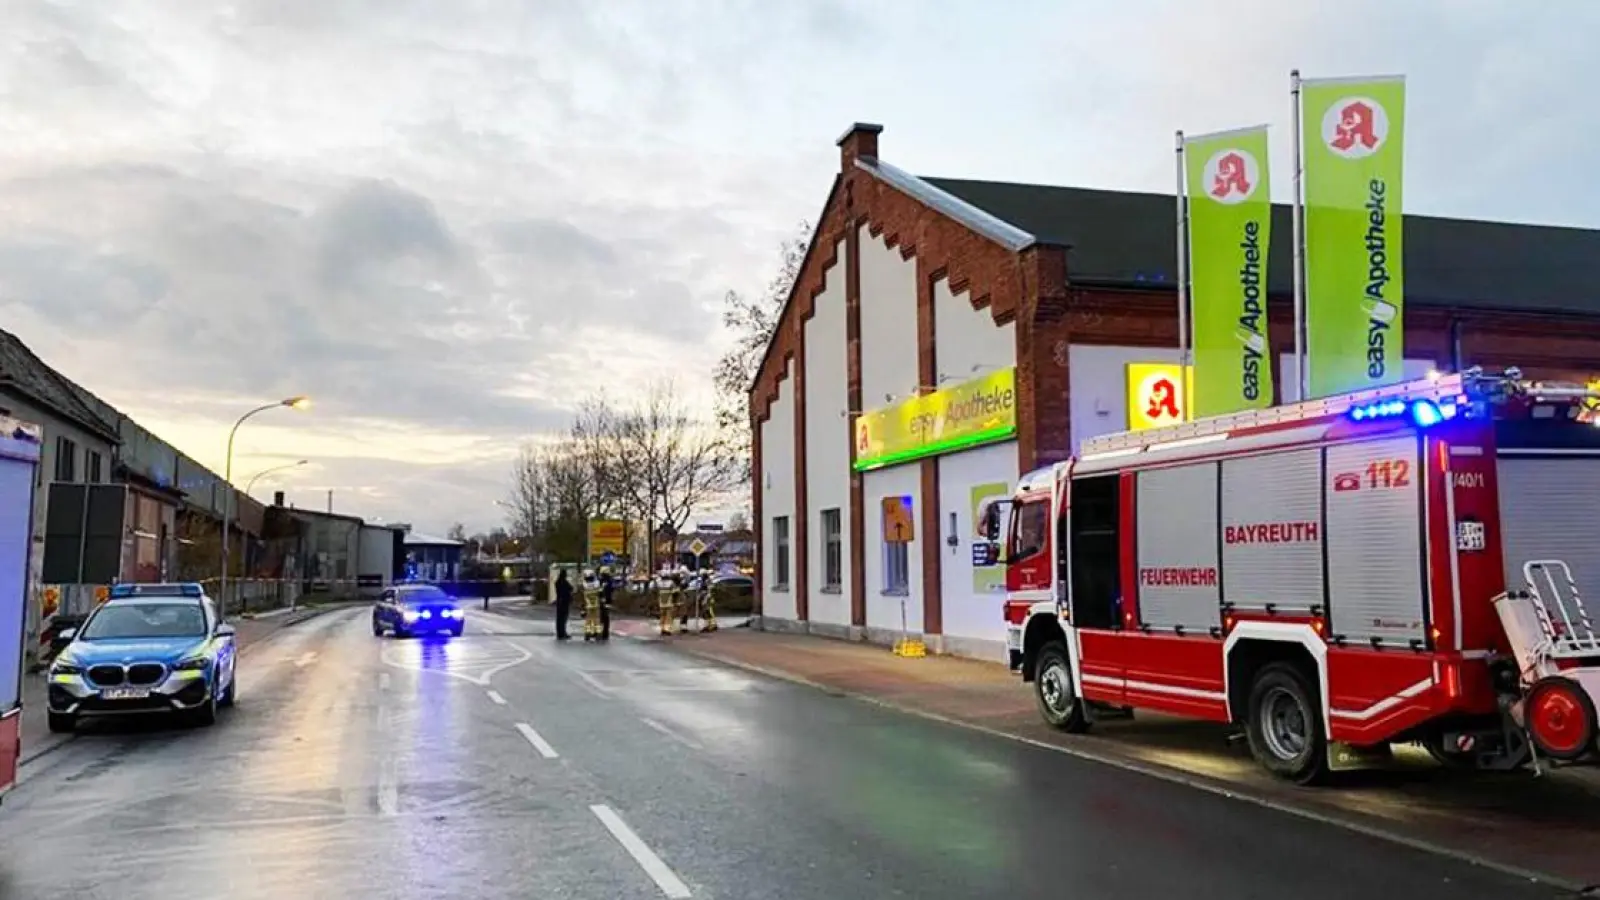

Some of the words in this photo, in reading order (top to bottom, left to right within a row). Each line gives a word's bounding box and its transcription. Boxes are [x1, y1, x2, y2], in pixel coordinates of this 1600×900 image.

[1364, 179, 1391, 299] Apotheke
[1239, 220, 1263, 331] Apotheke
[945, 384, 1012, 425] Apotheke
[1365, 460, 1409, 488] 112
[1225, 522, 1318, 544] BAYREUTH
[1140, 567, 1217, 587] FEUERWEHR
